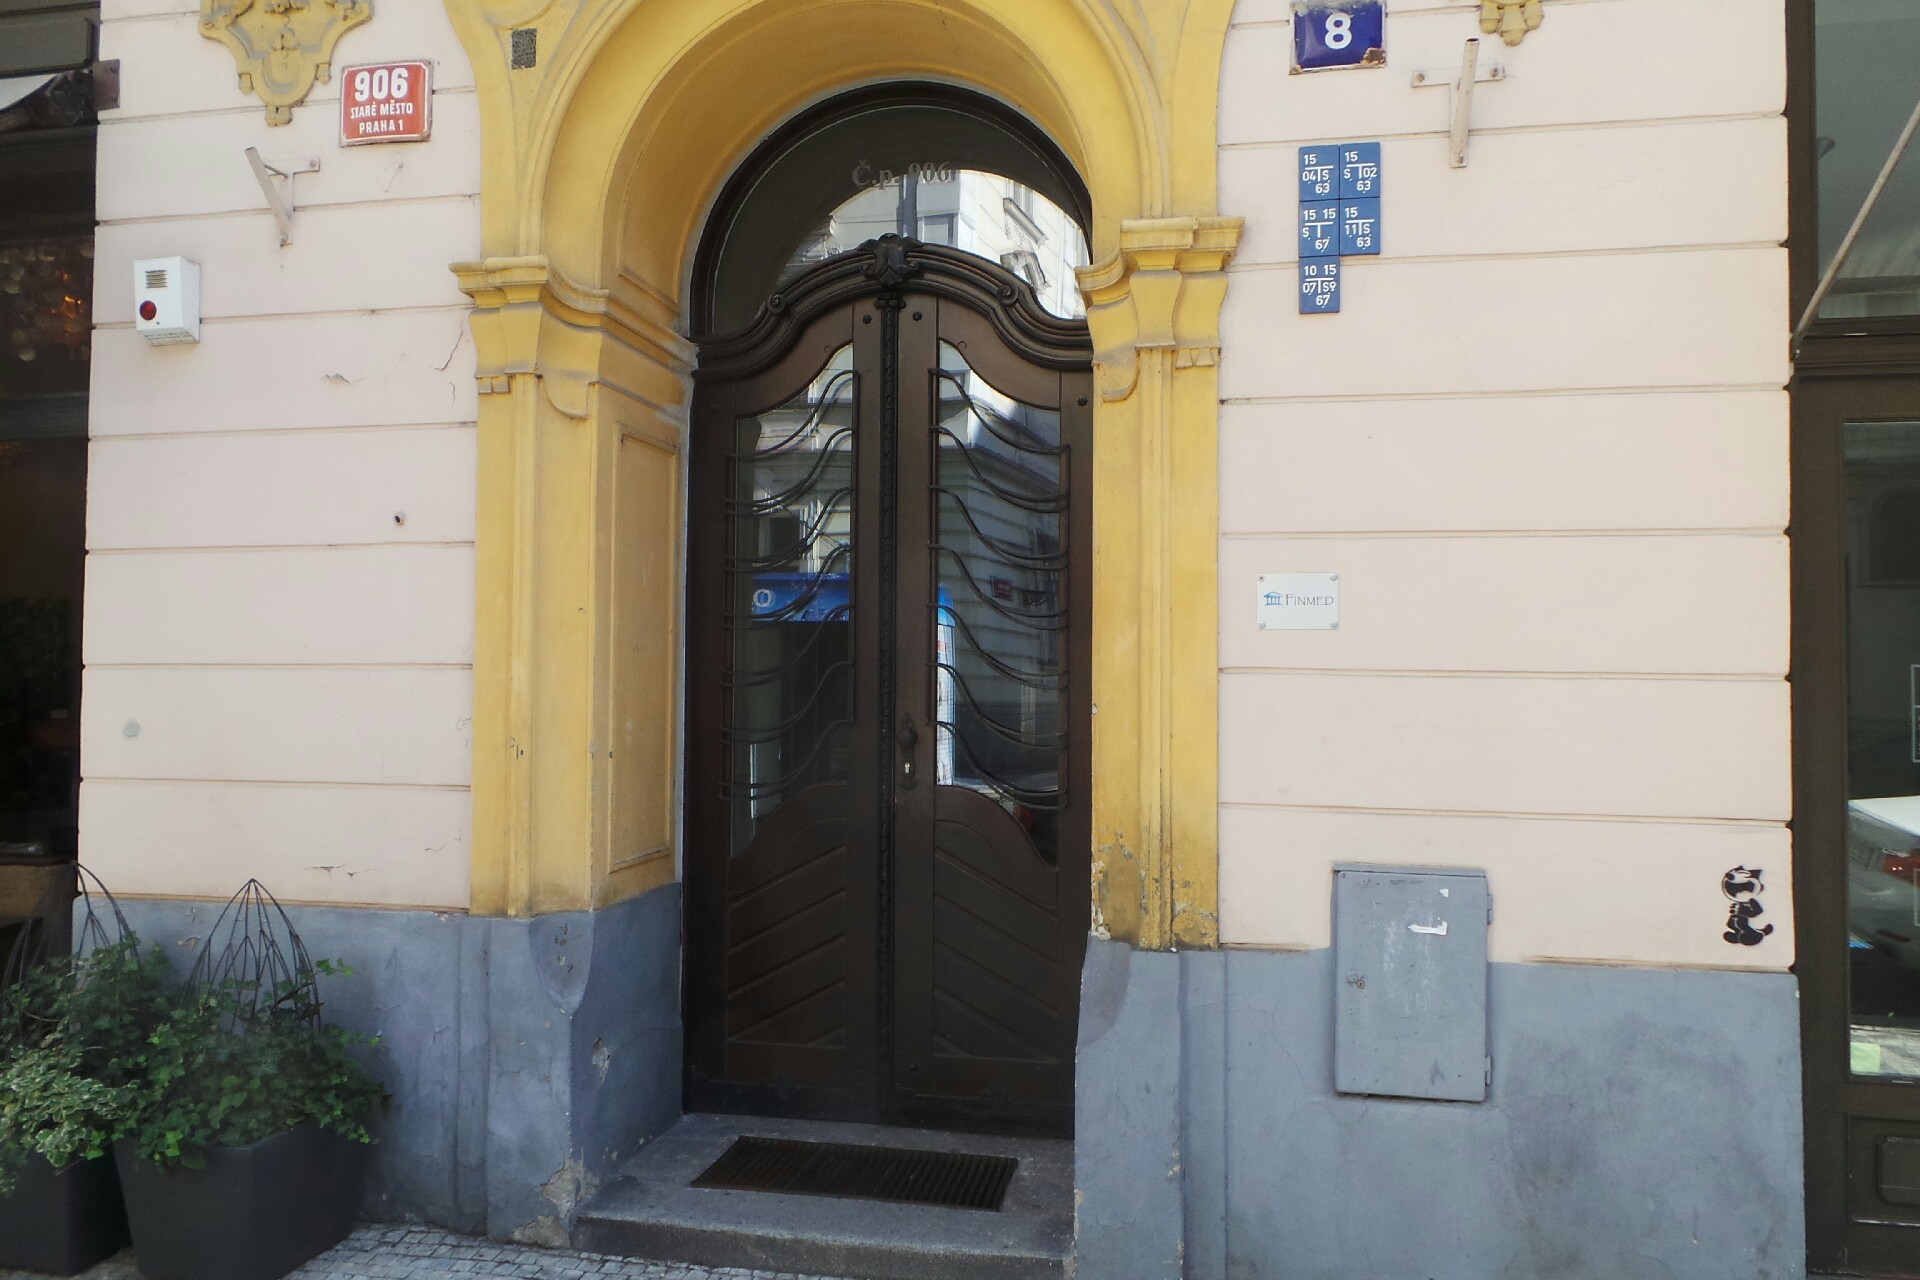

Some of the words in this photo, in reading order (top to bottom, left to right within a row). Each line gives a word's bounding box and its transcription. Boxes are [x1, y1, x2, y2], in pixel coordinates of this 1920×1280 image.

[1324, 12, 1352, 50] 8
[354, 67, 409, 102] 906
[350, 101, 377, 119] STARÉ
[379, 99, 413, 116] MĚSTO
[359, 119, 396, 134] PRAHA
[398, 119, 404, 131] 1
[1303, 153, 1317, 165] 15
[1345, 151, 1358, 163] 15
[908, 161, 952, 182] 906
[1303, 209, 1317, 221] 15
[1323, 208, 1336, 220] 15
[1344, 206, 1358, 218] 15
[1304, 265, 1317, 276] 10
[1323, 264, 1337, 276] 15
[1285, 593, 1334, 606] FINMED
